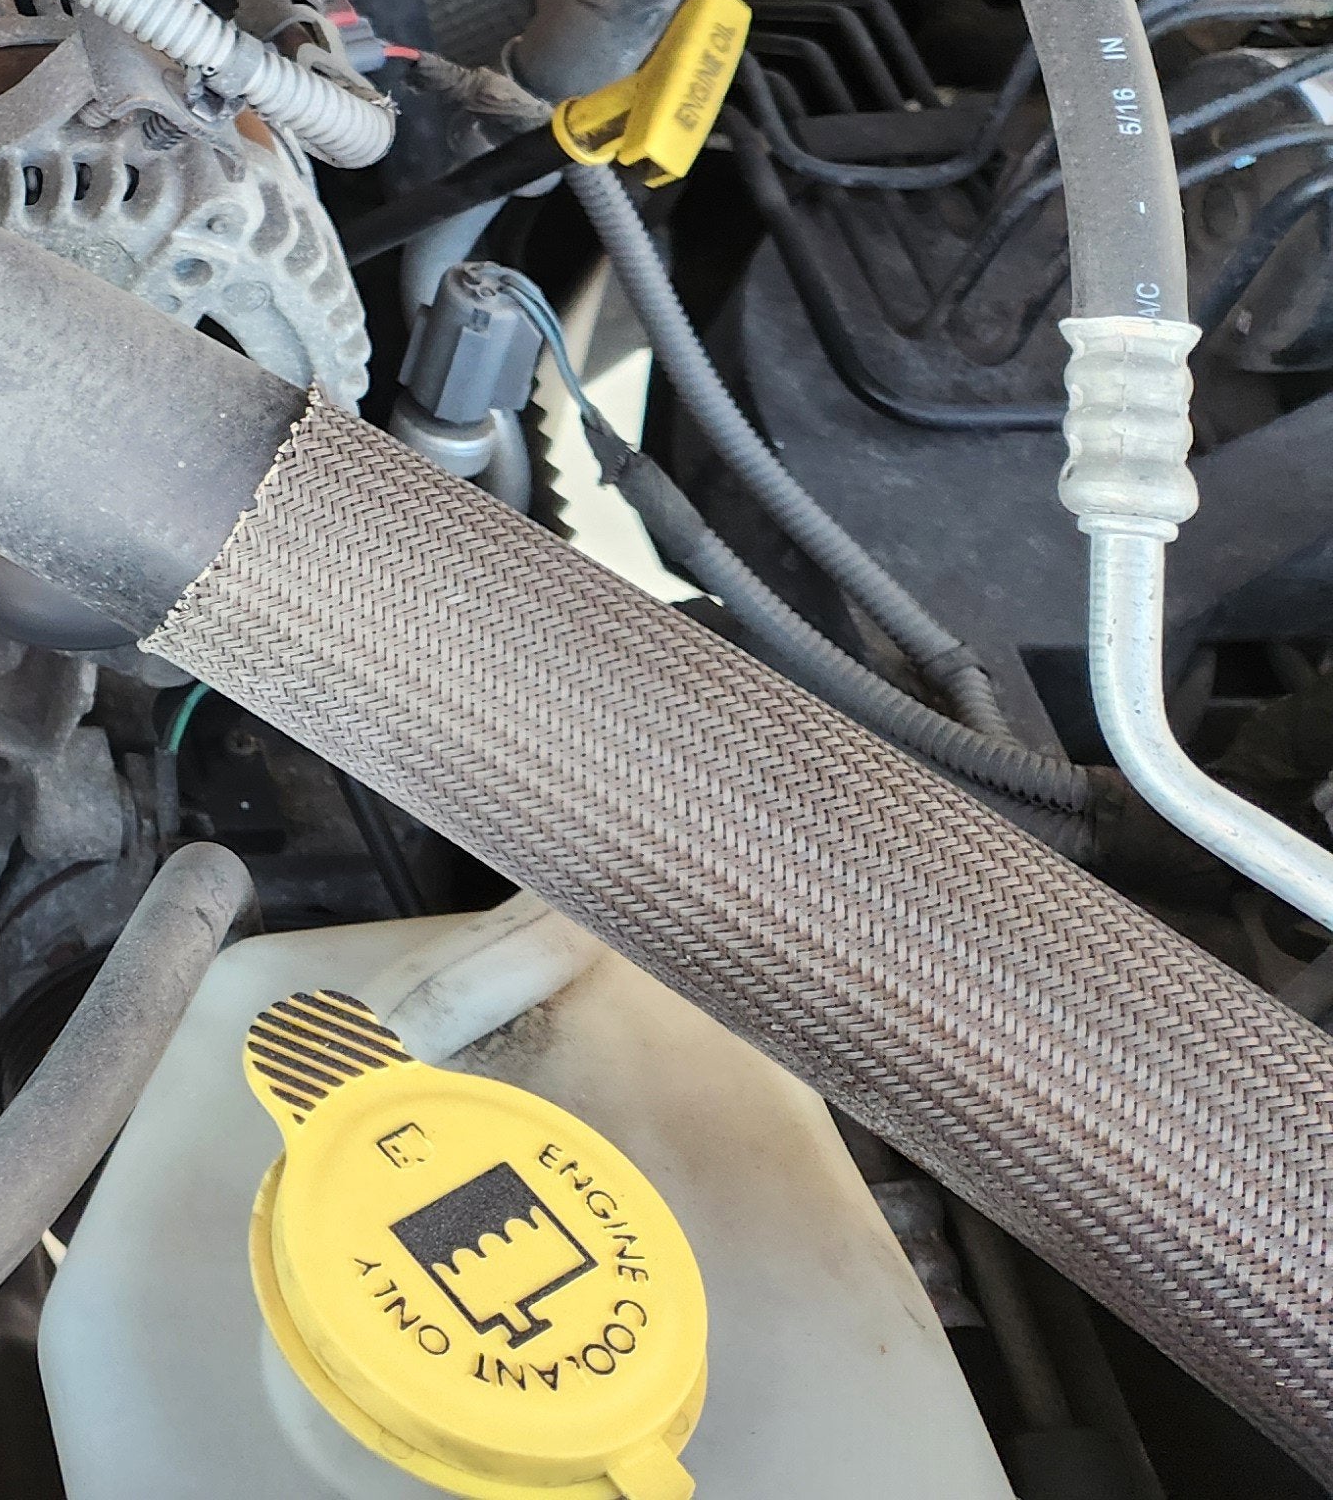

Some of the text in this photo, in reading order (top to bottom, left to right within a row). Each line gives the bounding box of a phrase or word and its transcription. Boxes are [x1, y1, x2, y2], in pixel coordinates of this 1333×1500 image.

[1098, 37, 1128, 60] IN
[1112, 87, 1143, 136] 5/16
[1135, 282, 1162, 318] A/C
[353, 1143, 650, 1392] ENGINE COOLANT ONLY
